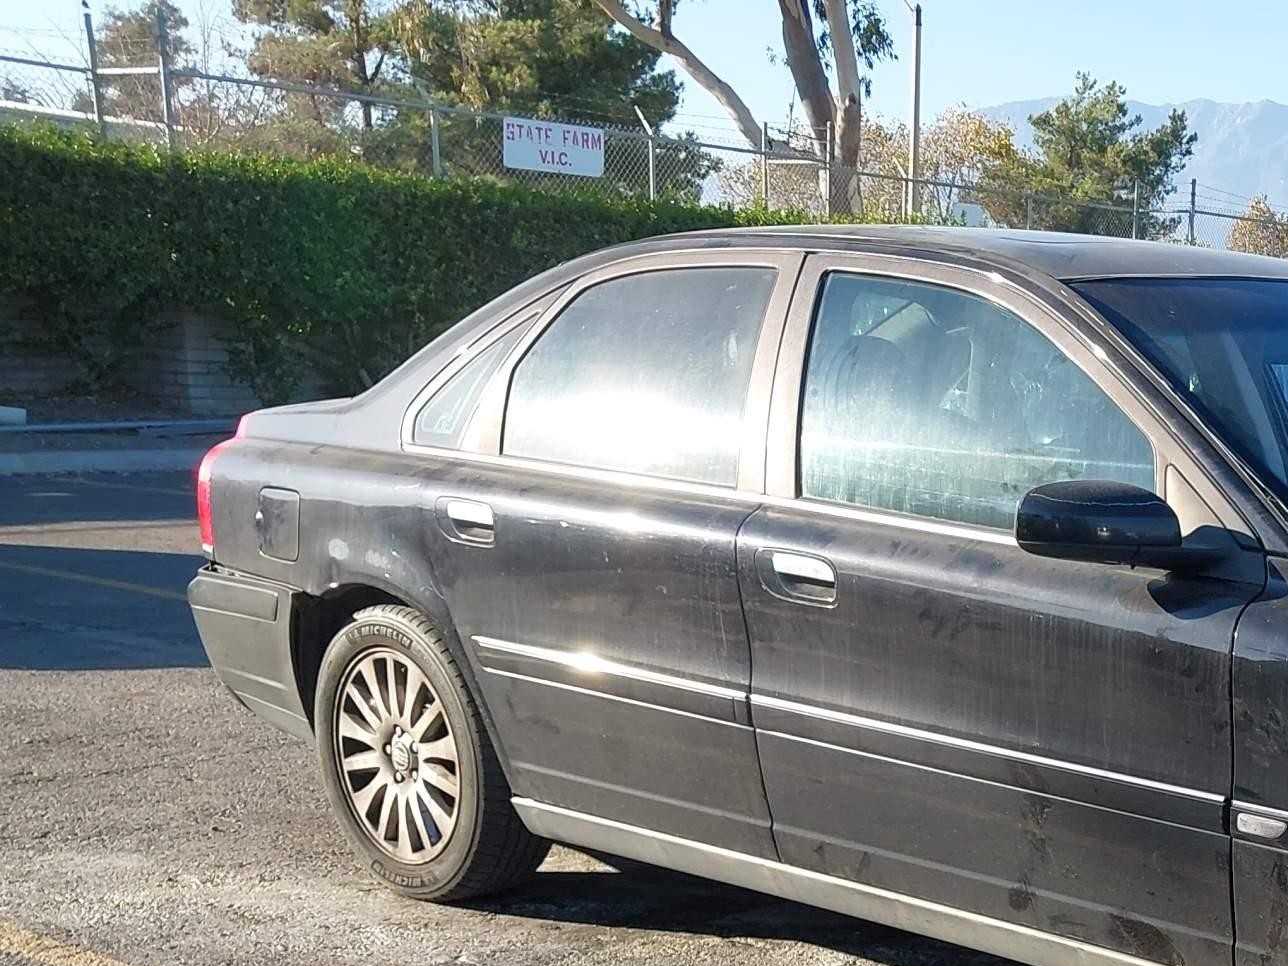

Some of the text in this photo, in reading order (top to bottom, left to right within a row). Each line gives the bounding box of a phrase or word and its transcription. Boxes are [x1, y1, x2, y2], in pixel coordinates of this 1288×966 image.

[506, 123, 602, 151] STATE FARM
[539, 149, 573, 168] V.I.C.
[361, 624, 412, 648] MICHELIN
